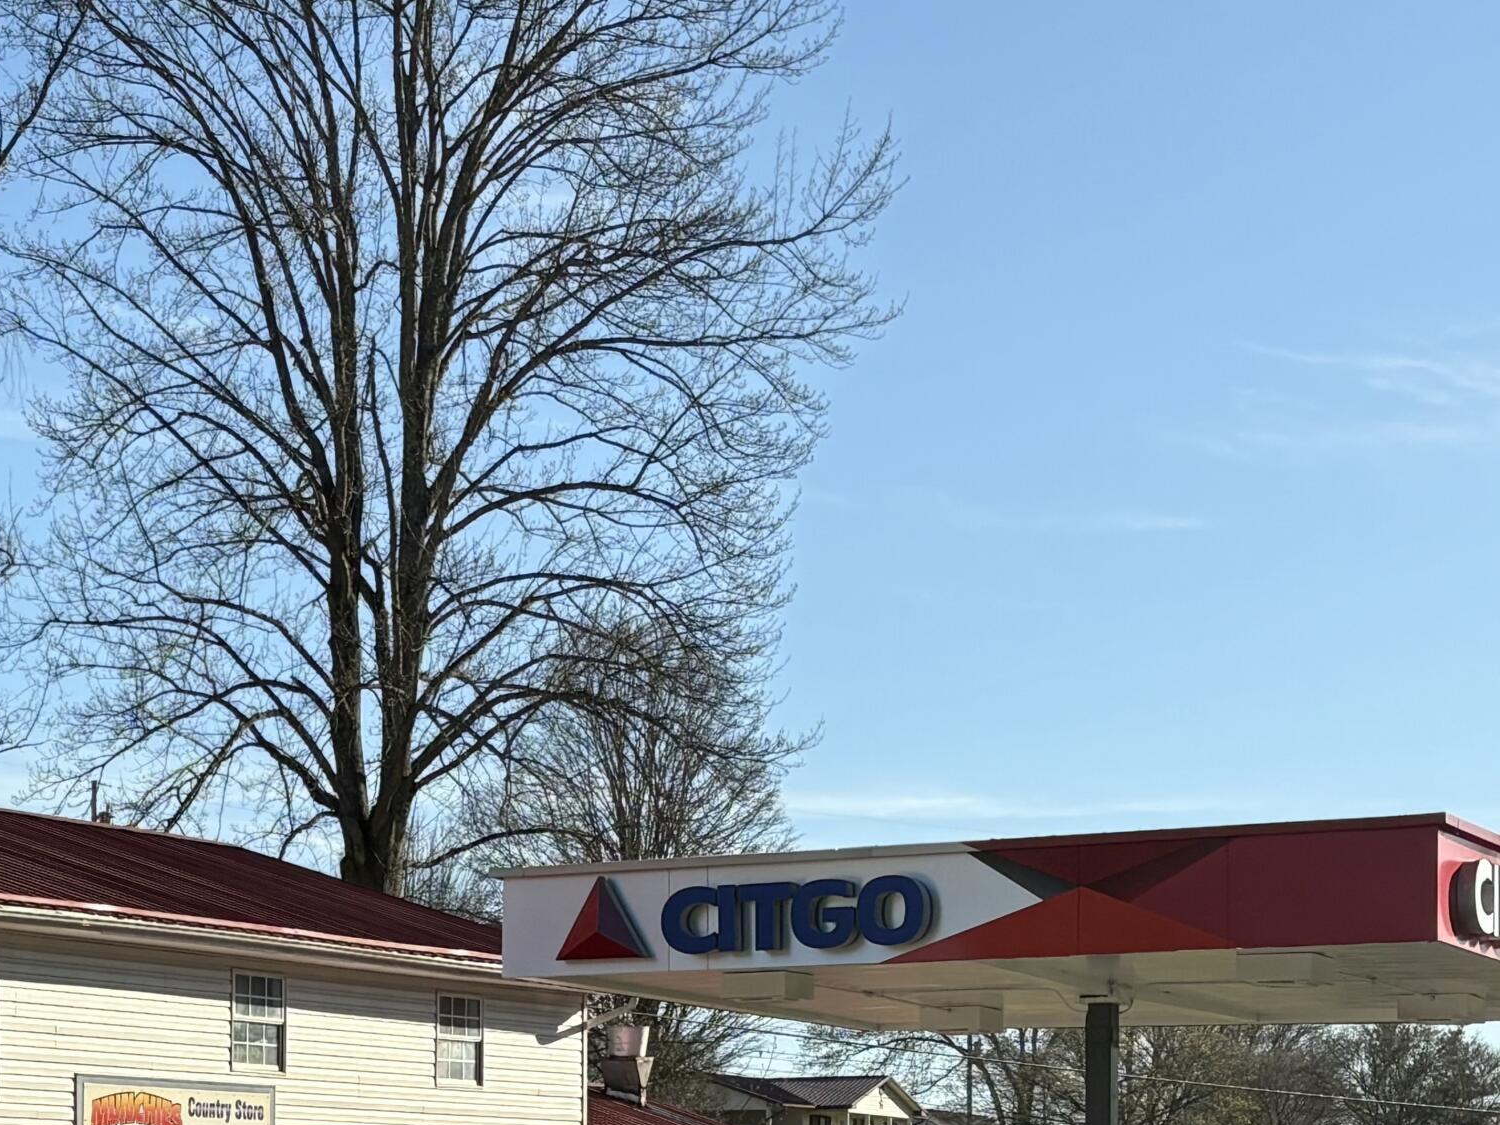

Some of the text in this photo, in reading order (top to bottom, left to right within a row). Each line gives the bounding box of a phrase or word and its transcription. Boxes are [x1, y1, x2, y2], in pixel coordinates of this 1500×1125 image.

[661, 875, 930, 955] CITGO
[187, 1096, 264, 1124] Country Store
